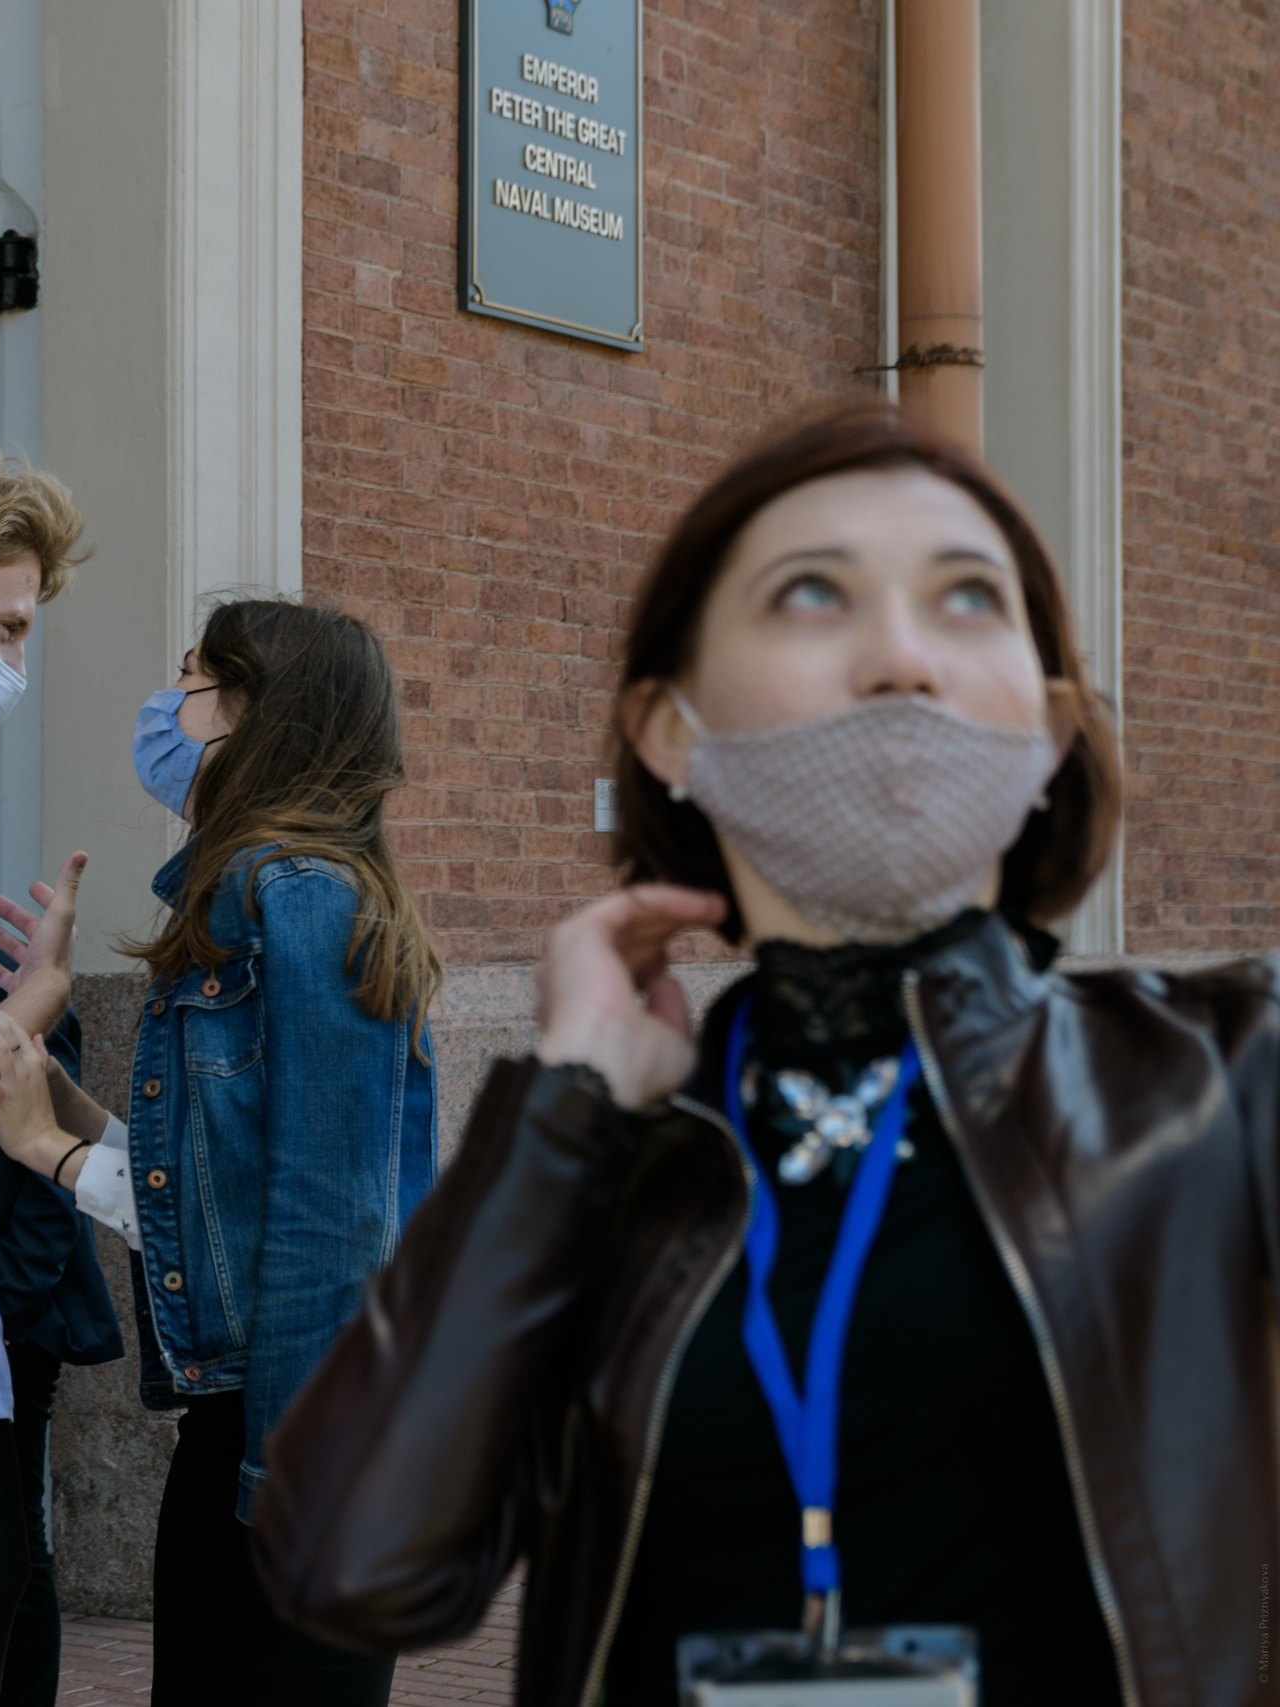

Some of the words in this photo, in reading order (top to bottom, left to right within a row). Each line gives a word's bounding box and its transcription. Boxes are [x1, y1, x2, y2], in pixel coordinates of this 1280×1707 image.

[522, 53, 598, 104] EMPEROR
[491, 87, 542, 129] PETER
[545, 104, 577, 139] THE
[577, 116, 627, 156] GREAT
[524, 143, 597, 190] CENTRAL
[495, 178, 552, 219] NAVAL
[553, 196, 623, 240] MUSEUM
